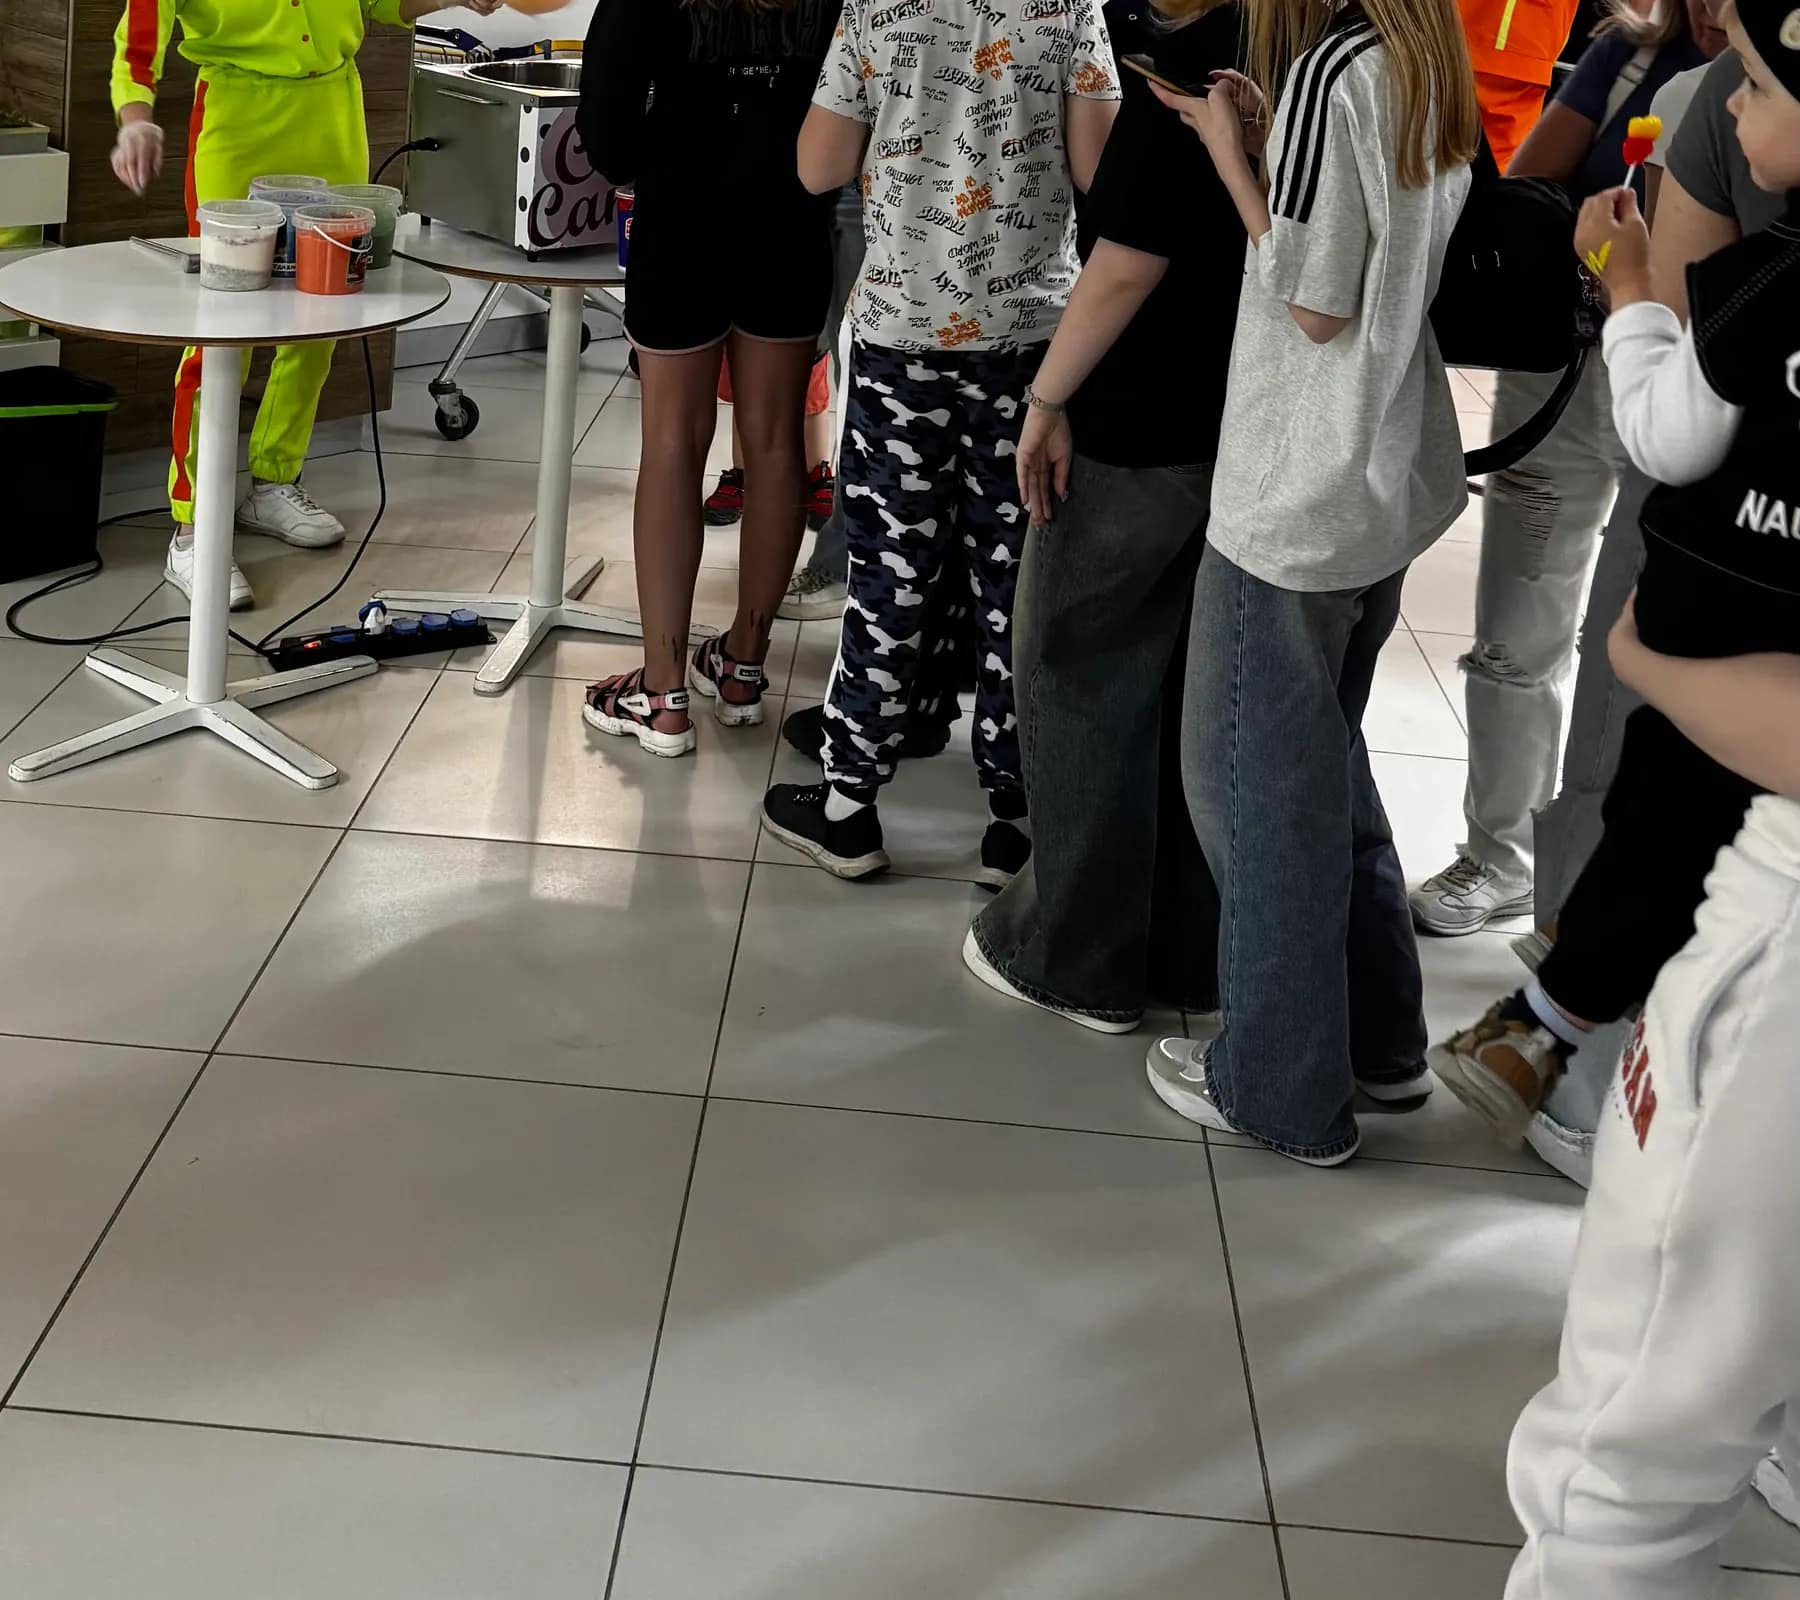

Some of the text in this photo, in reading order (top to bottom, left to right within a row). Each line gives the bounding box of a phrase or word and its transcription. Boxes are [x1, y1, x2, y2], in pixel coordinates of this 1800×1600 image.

[884, 32, 938, 45] CHALLENGE
[896, 44, 917, 57] THE
[890, 57, 918, 68] RULES
